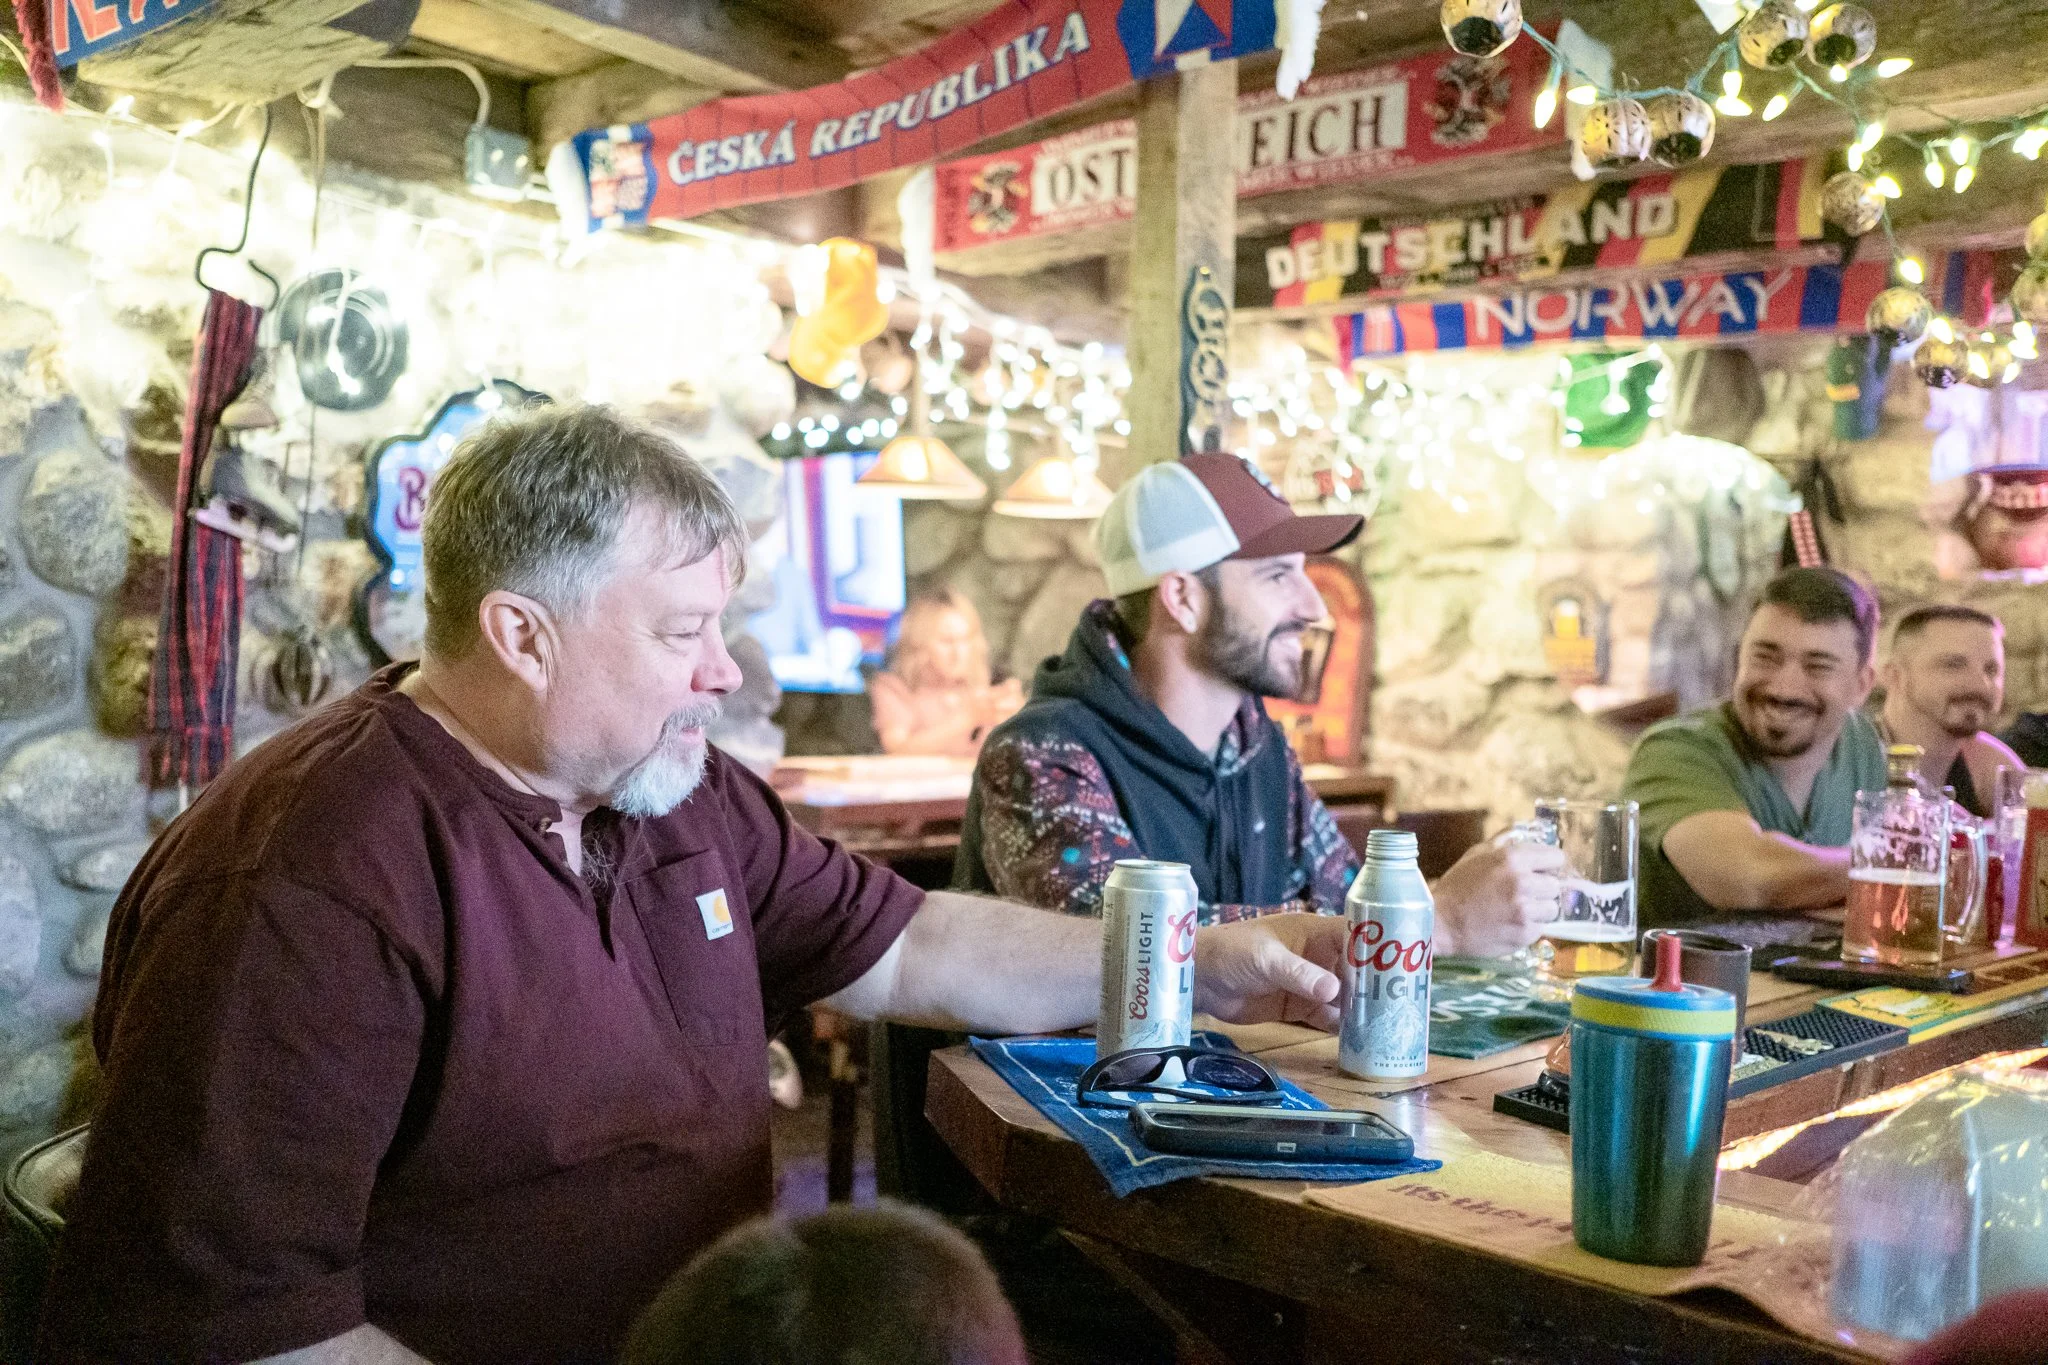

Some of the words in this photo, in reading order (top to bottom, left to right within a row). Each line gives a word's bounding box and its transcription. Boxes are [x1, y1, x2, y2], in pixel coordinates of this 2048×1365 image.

[667, 119, 796, 186] ČESKÁ
[808, 11, 1090, 159] REPUBLIKA
[1264, 191, 1680, 290] DEUTSCHLAND
[1473, 266, 1794, 339] NORWAY
[1138, 911, 1154, 964] LIGHT
[1128, 967, 1151, 1021] Coors
[1354, 971, 1429, 1001] LIGH
